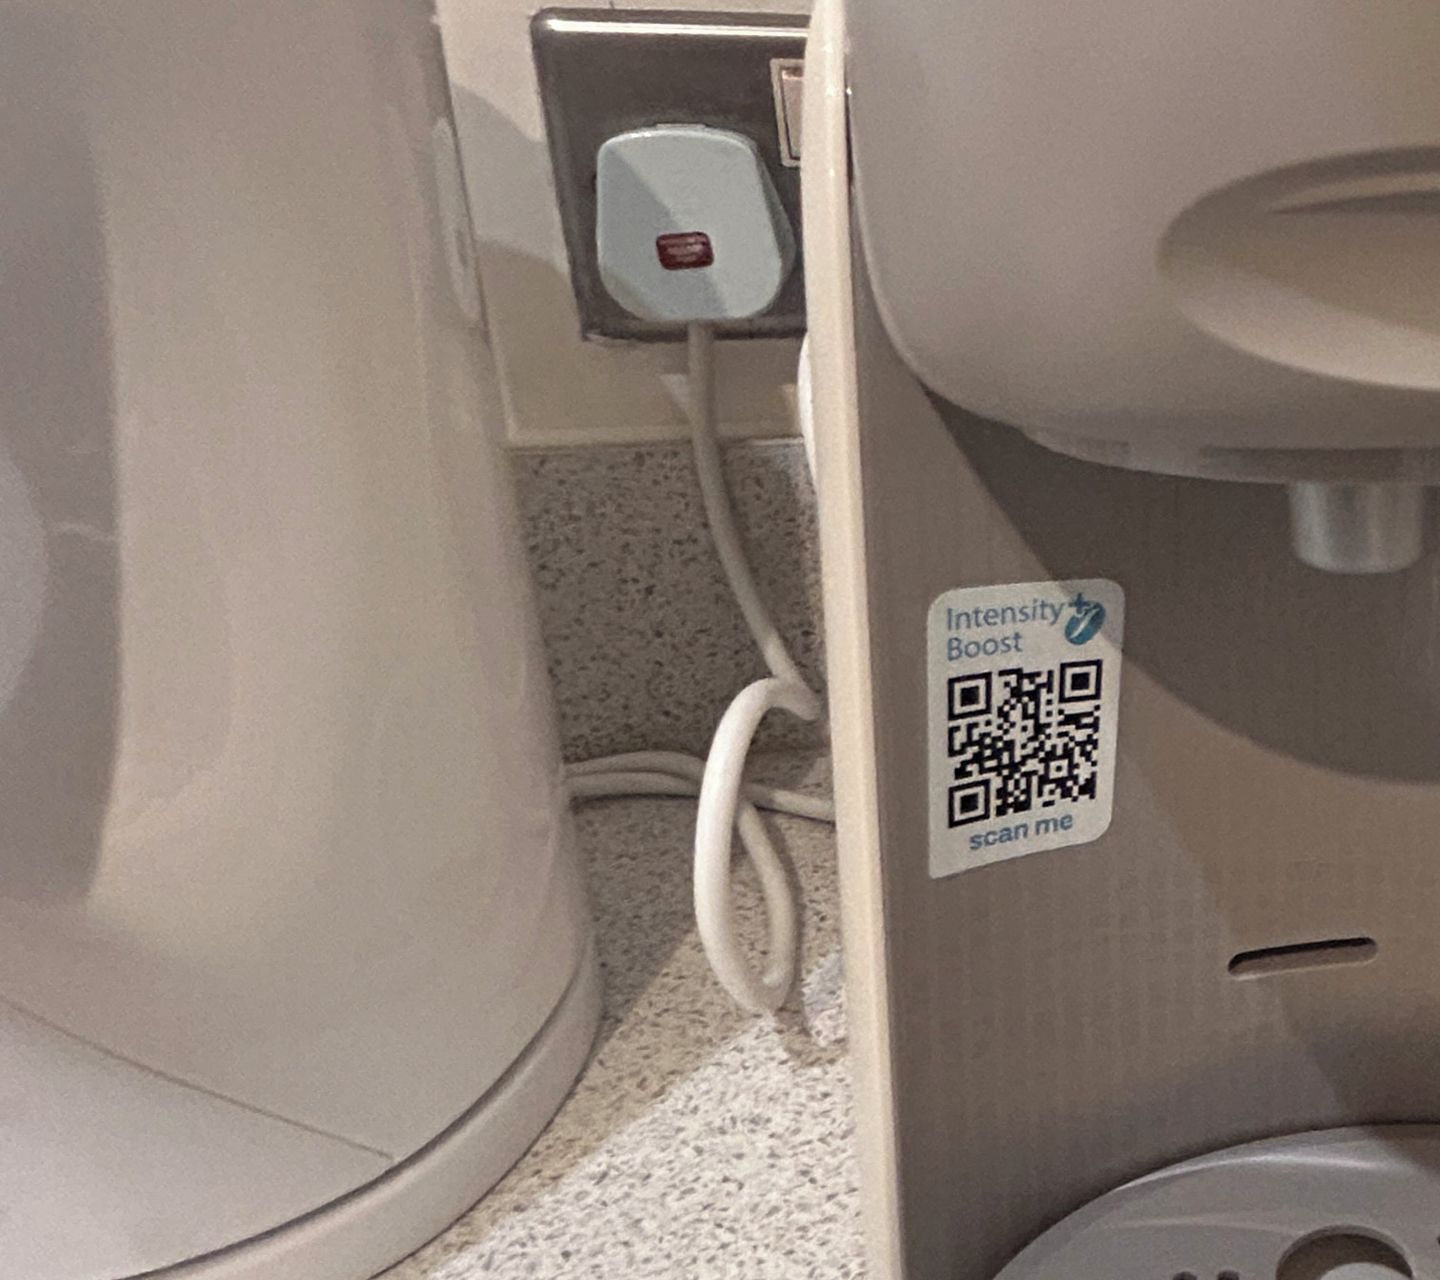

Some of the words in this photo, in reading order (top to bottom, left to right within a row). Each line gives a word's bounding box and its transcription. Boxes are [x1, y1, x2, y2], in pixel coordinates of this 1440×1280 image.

[946, 598, 1065, 631] Intensity
[947, 632, 1023, 661] Boost
[968, 822, 1030, 851] scan
[1035, 811, 1075, 836] me
